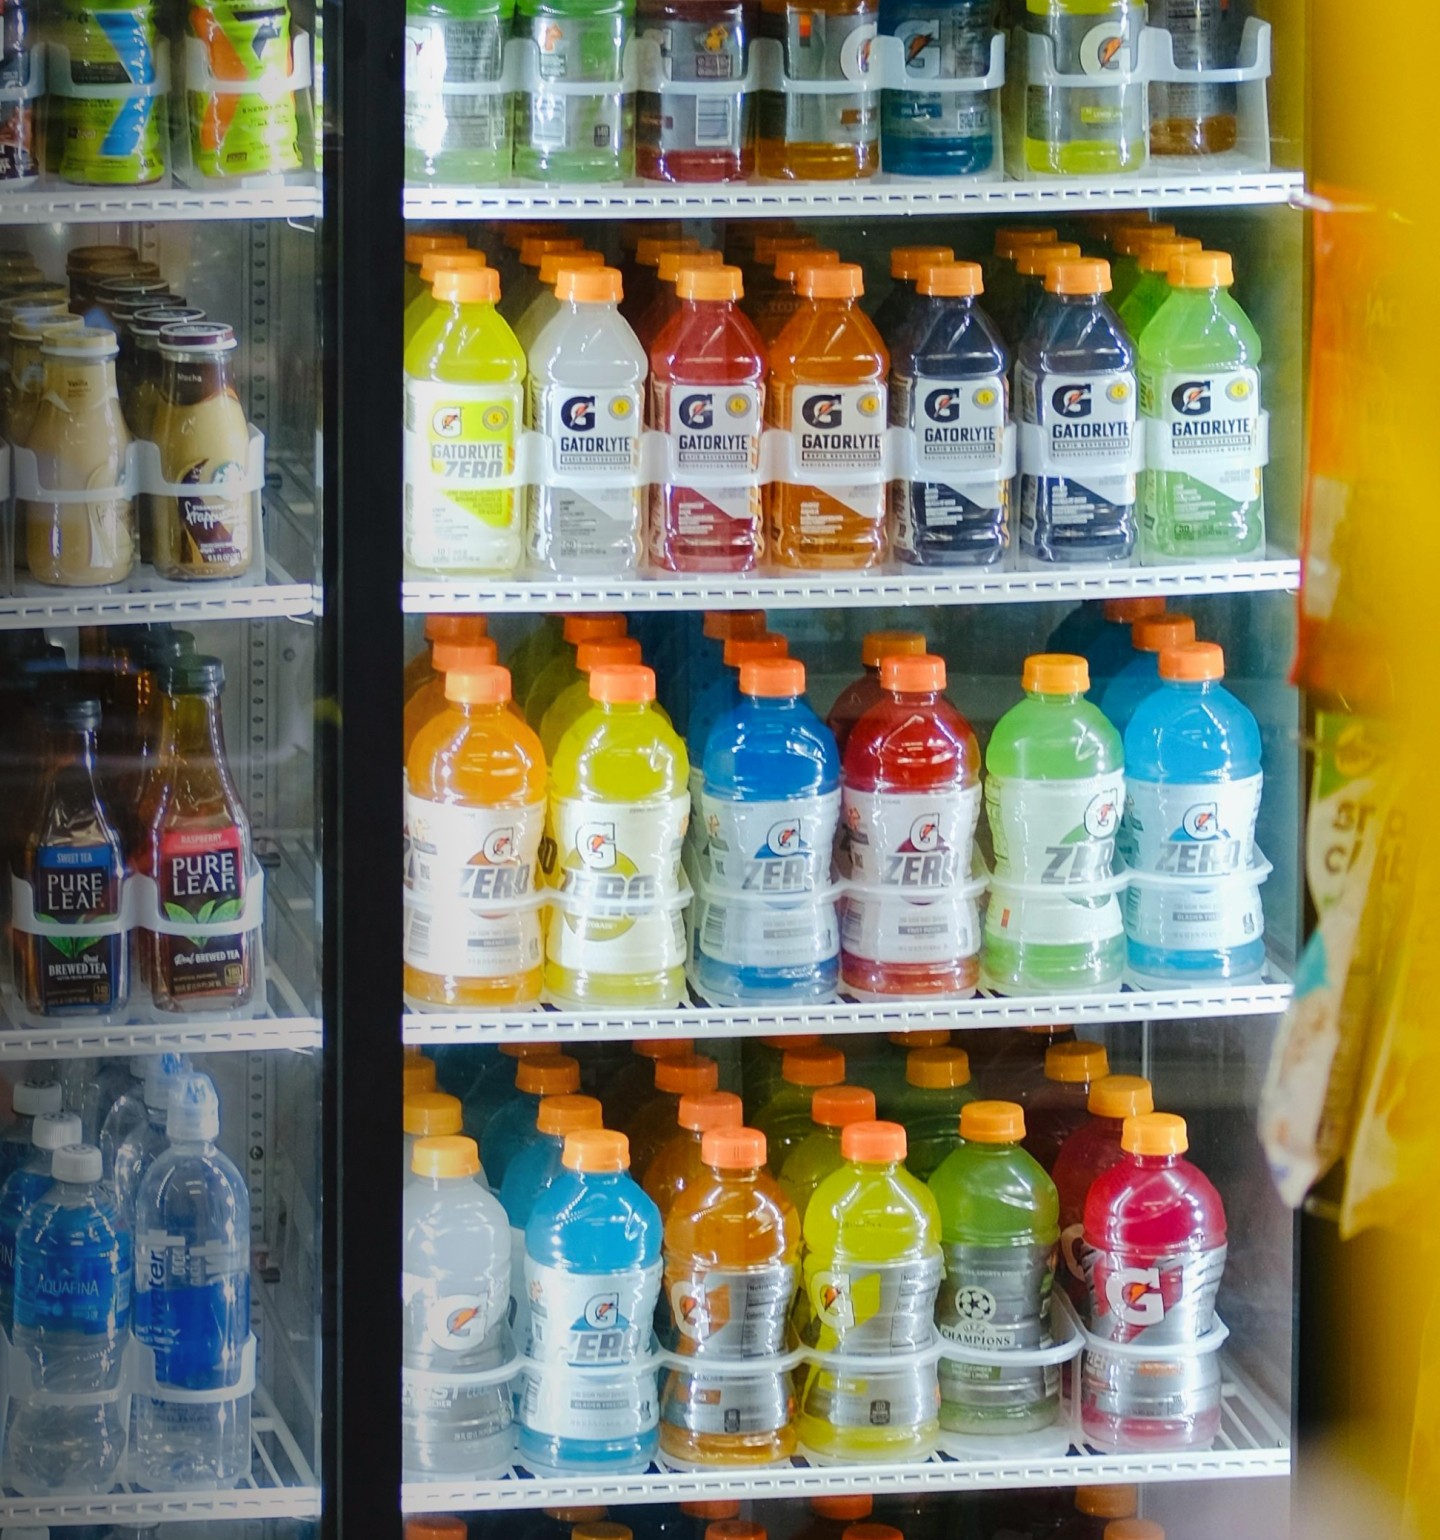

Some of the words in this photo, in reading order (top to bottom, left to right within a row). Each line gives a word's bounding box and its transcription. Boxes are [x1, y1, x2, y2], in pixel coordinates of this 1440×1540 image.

[176, 372, 203, 384] Mocha
[924, 387, 960, 423] G
[1051, 383, 1092, 418] G
[1171, 380, 1211, 416] G
[560, 395, 596, 432] G
[678, 393, 713, 430] G
[801, 393, 842, 430] G
[924, 425, 995, 443] GATORLYTE
[1052, 421, 1129, 439] GATORLYTE
[1172, 417, 1250, 436] GATORLYTE
[560, 436, 631, 452] GATORLYTE
[679, 434, 748, 450] GATORLYTE
[802, 433, 881, 449] GATORLYTE
[431, 442, 503, 460] GATORLYTE
[444, 460, 503, 479] ZERO
[180, 832, 223, 845] RASPBERRY
[56, 852, 78, 864] SWEET
[79, 852, 93, 863] TEA
[172, 852, 234, 877] PURE
[880, 852, 959, 887] ZERO
[47, 872, 103, 892] PURE
[459, 864, 530, 899] ZERO
[195, 950, 226, 964] BREWED
[226, 949, 241, 960] TEA
[48, 962, 89, 977] BREWED
[89, 962, 108, 975] TEA
[36, 1279, 99, 1297] AQUAFINA
[1106, 1267, 1165, 1327] G
[941, 1328, 1011, 1345] CHAMPIONS
